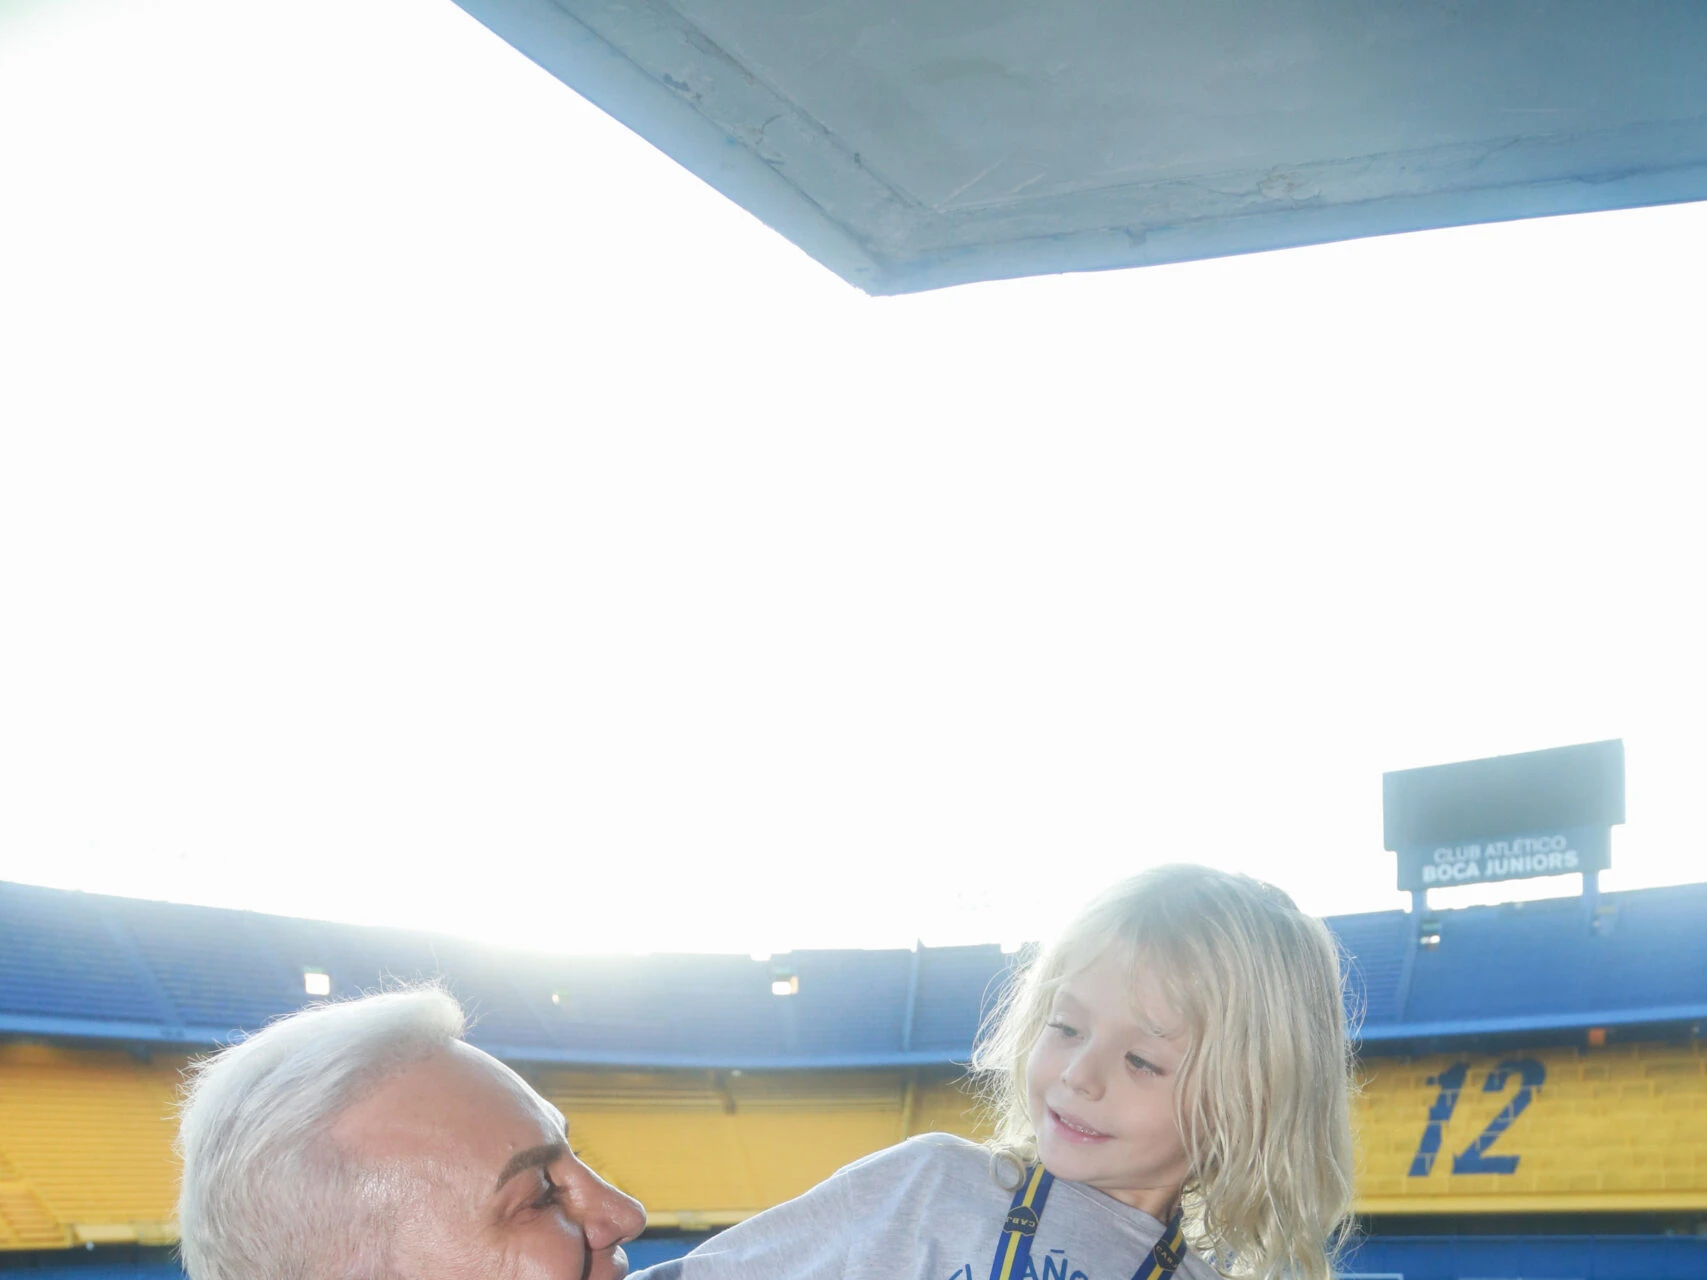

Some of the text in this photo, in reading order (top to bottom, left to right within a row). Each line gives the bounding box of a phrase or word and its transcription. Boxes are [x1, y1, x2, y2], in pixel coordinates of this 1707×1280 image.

[1422, 851, 1579, 882] BOCA JUNIORS
[1433, 845, 1481, 863] CLUB
[1408, 1058, 1547, 1177] 12
